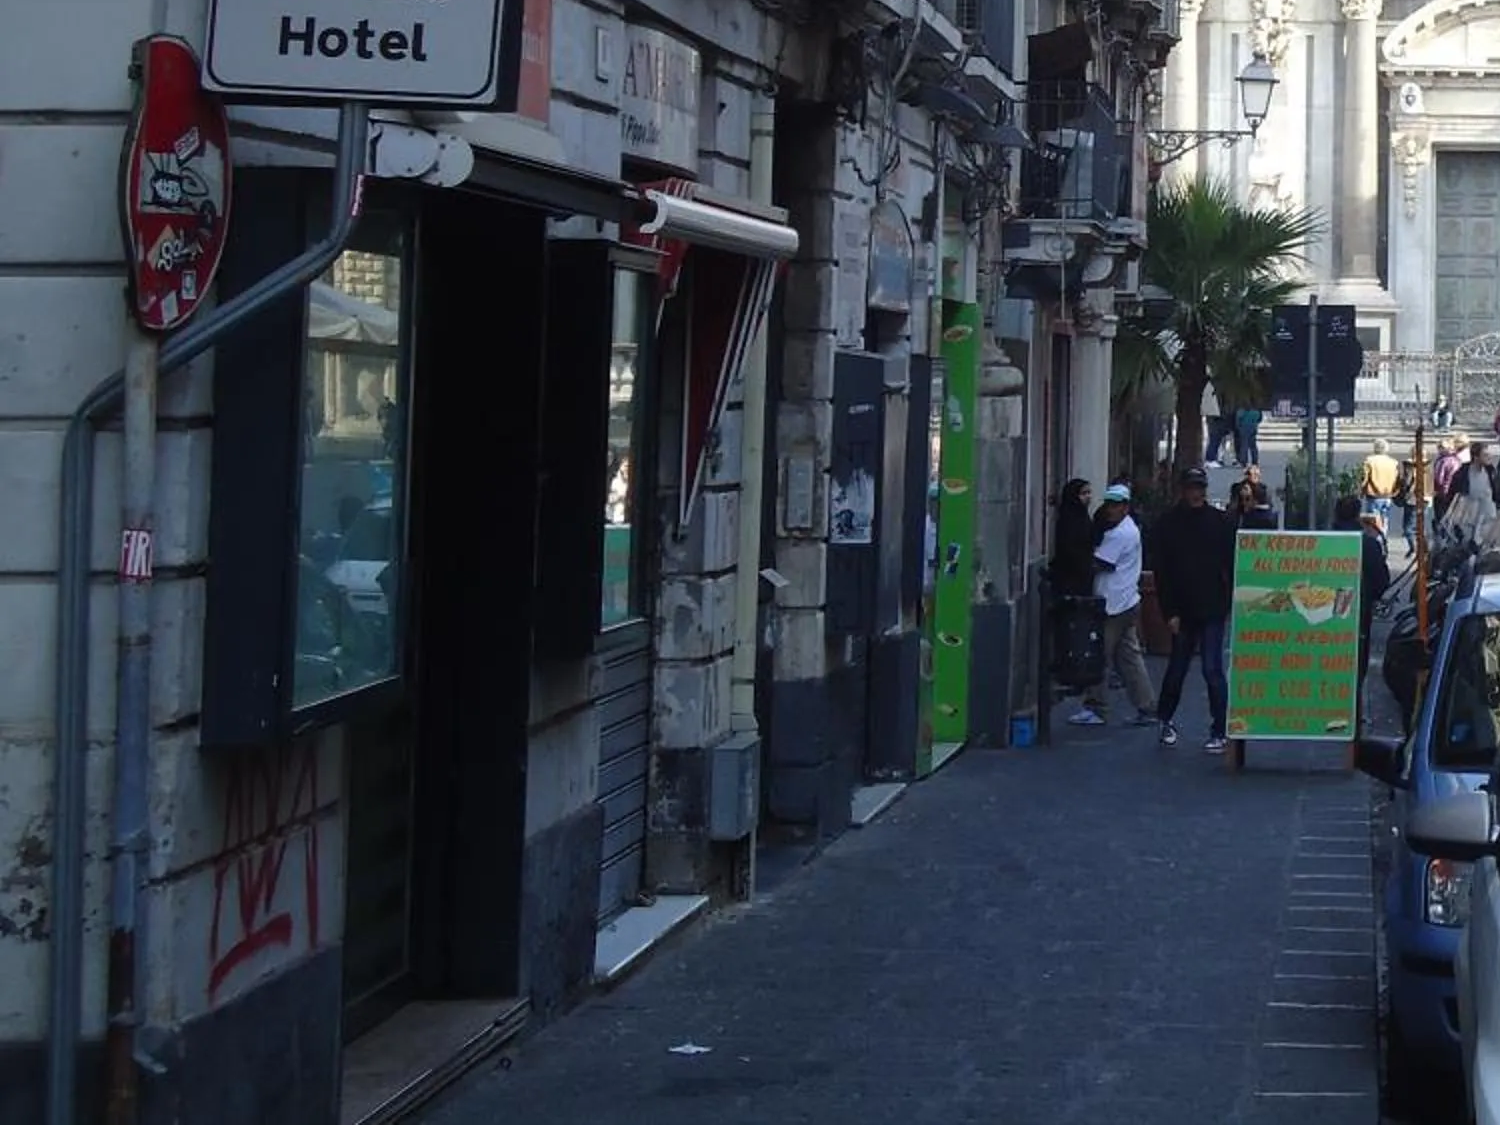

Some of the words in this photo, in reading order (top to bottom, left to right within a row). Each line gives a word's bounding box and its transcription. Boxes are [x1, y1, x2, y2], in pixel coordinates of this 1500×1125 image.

[278, 16, 427, 61] Hotel
[1278, 557, 1321, 572] INDIAN
[1324, 557, 1359, 572] FOOD
